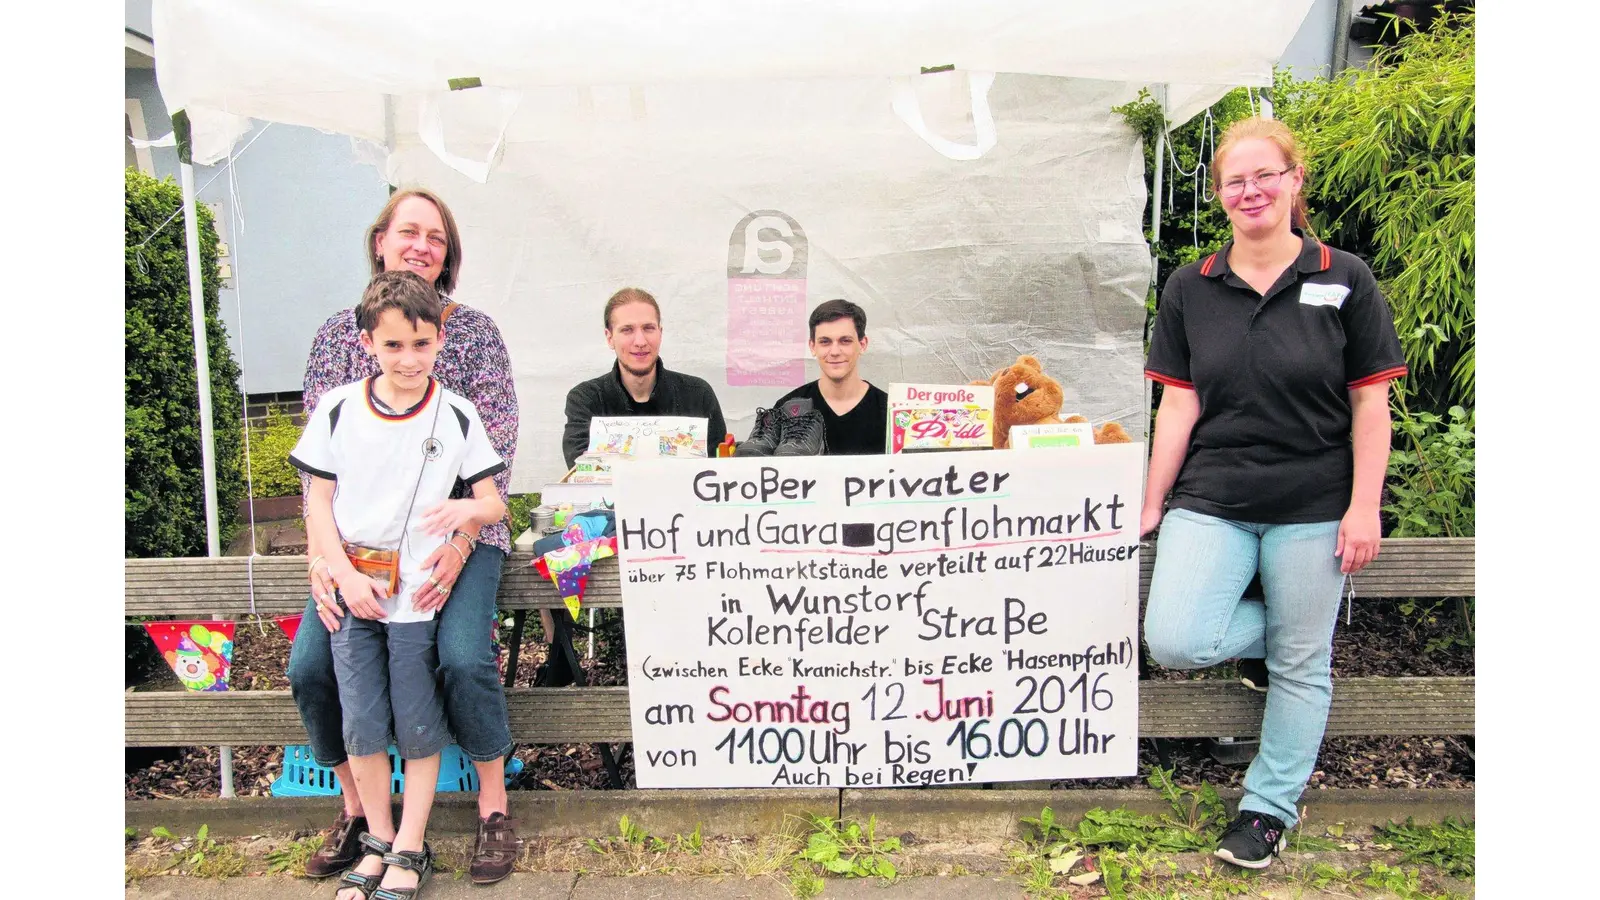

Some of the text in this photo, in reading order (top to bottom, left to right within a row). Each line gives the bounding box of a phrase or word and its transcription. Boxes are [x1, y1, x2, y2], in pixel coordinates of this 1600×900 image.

[907, 387, 975, 404] Der große
[693, 465, 1010, 506] Großer privater
[622, 513, 684, 554] Hof
[696, 513, 750, 547] und
[628, 542, 1139, 583] über 75 Flohmarktstände verteilt auf 22 Häuser
[721, 580, 932, 617] in Wunstorf
[708, 597, 1048, 651] Kolenfelder Straße
[642, 655, 728, 681] (zwischen
[739, 656, 783, 677] Ecke
[904, 657, 933, 677] bis
[941, 652, 993, 675] Ecke
[645, 703, 694, 725] am
[706, 685, 850, 735] Sonntag
[1012, 672, 1114, 715] 2016
[646, 717, 1116, 767] von 11.00 Uhr bis 16.00 Uhr
[771, 763, 978, 786] Auch bei Regen!
